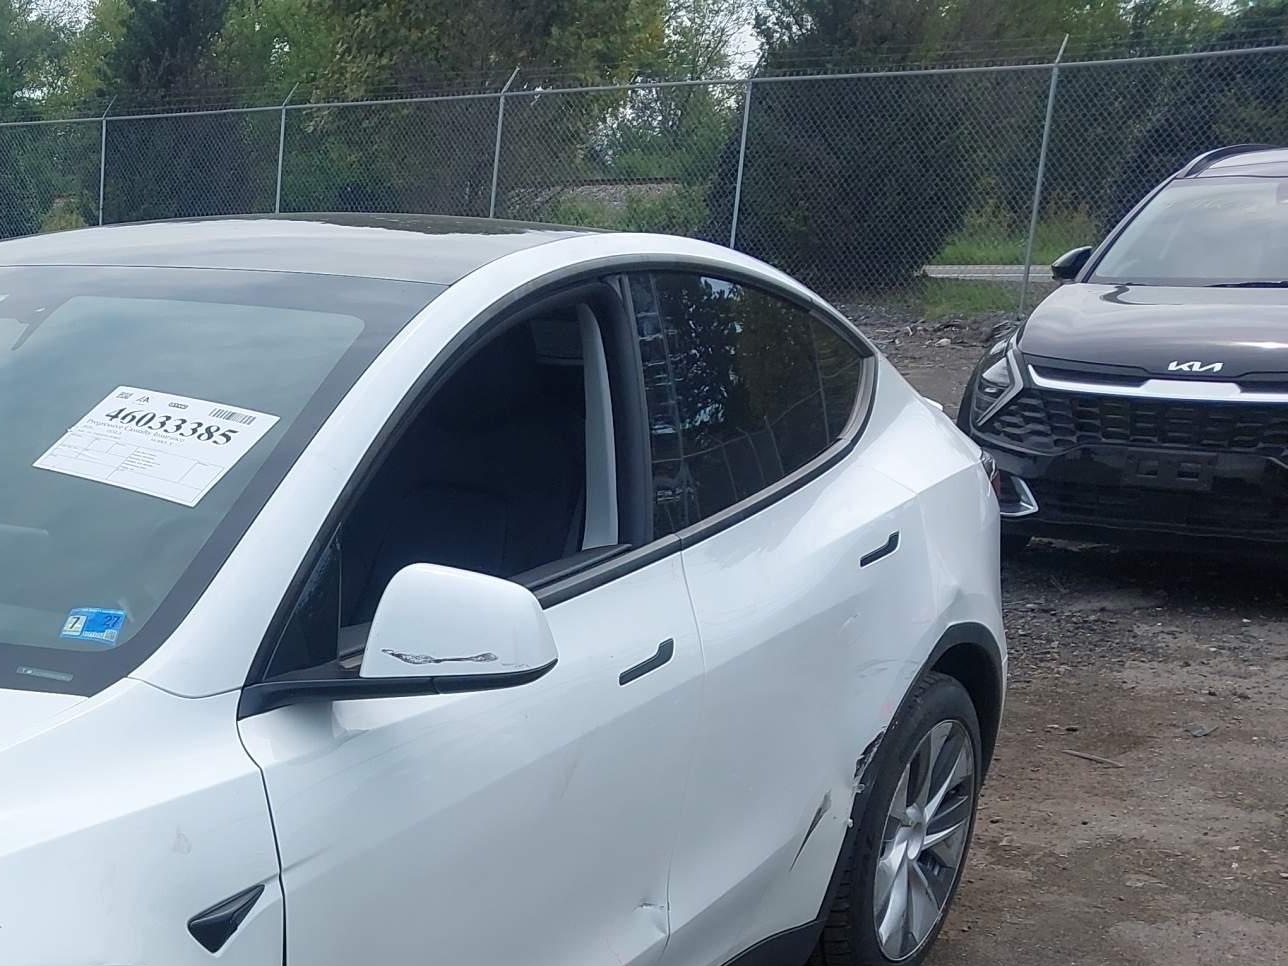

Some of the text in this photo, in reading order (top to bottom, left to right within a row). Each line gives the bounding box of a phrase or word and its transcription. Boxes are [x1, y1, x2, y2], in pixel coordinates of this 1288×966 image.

[1168, 361, 1224, 372] KIA
[105, 407, 239, 445] 46033385
[70, 617, 81, 629] 7
[103, 616, 120, 628] 27
